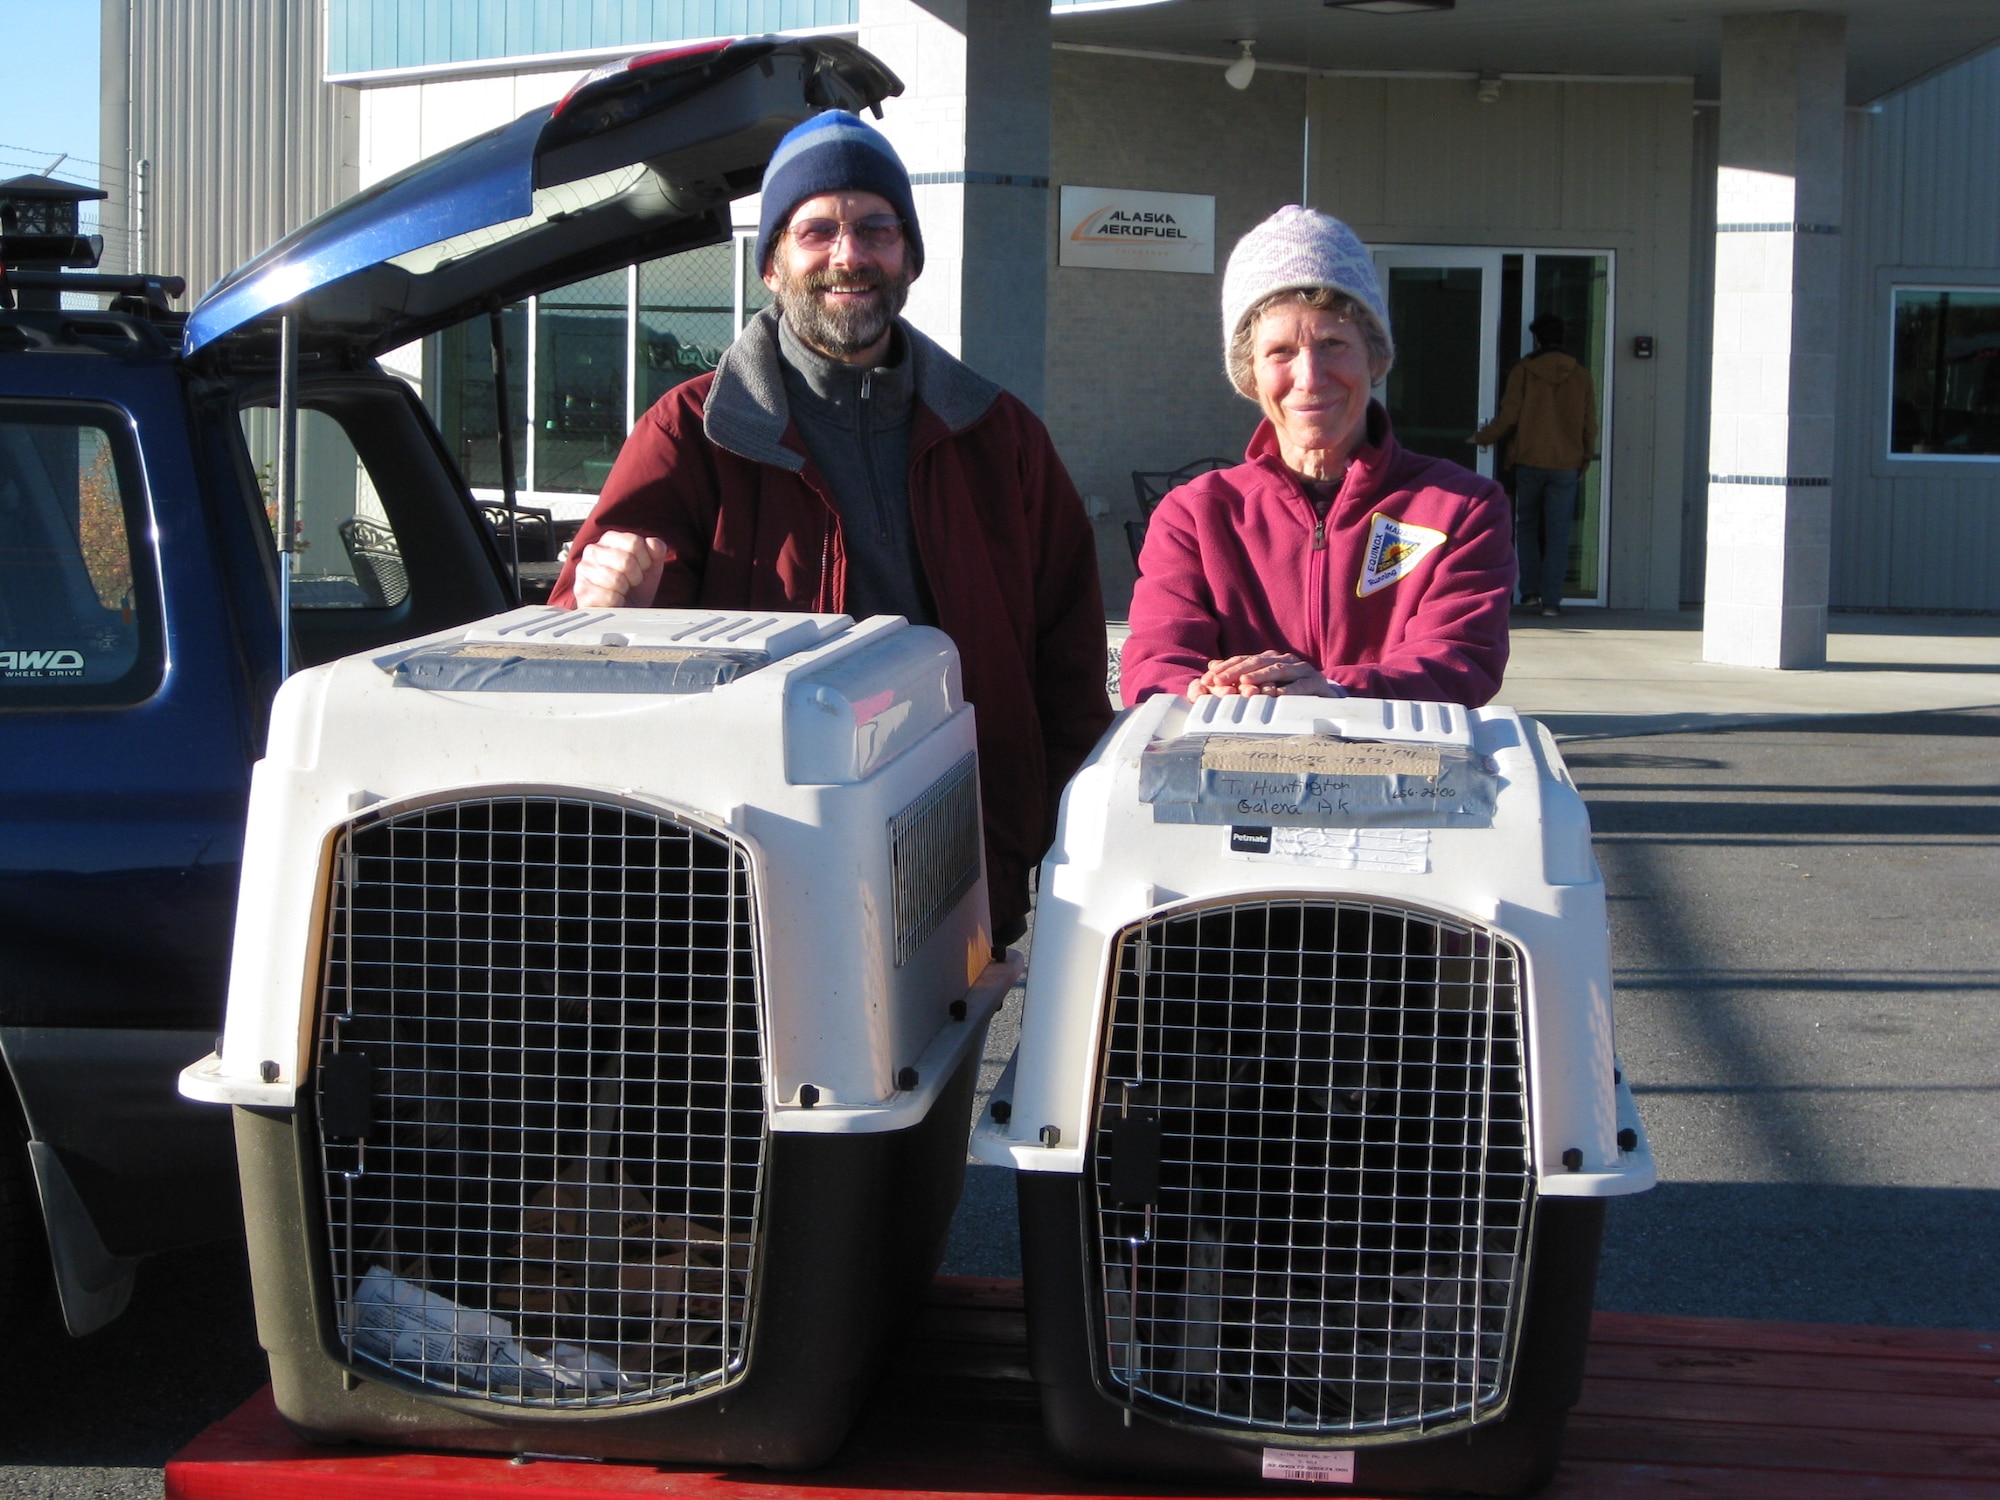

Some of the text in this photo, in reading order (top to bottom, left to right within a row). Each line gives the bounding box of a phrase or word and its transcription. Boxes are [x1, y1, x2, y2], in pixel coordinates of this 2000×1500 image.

[1109, 211, 1176, 224] ALASKA
[1097, 224, 1188, 238] AEROFUEL
[1367, 533, 1383, 572] EQUINOX
[1367, 569, 1397, 586] Running
[0, 650, 84, 670] AWD
[1237, 799, 1303, 815] Galena
[1232, 832, 1269, 843] Petmate
